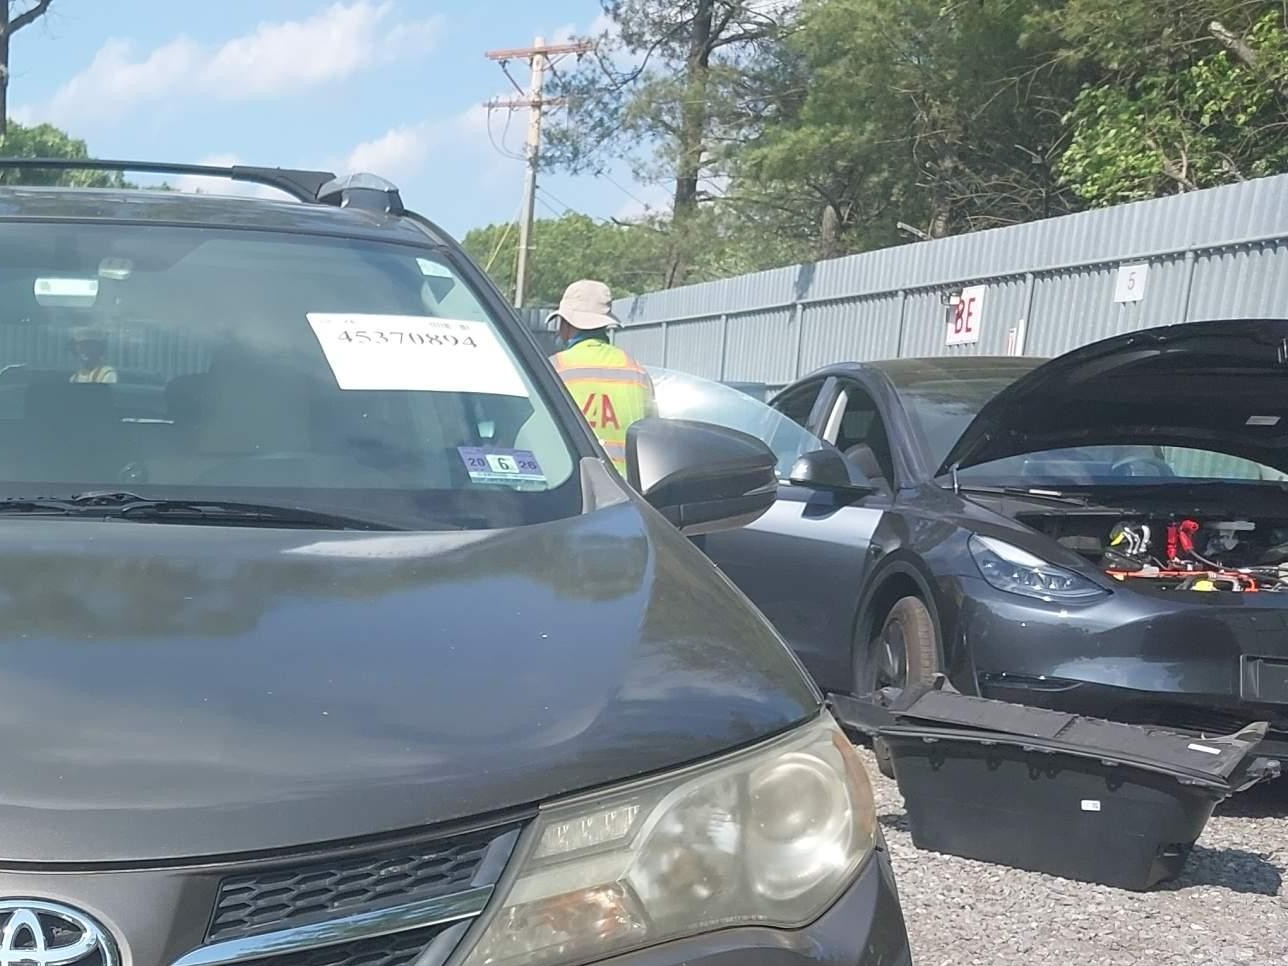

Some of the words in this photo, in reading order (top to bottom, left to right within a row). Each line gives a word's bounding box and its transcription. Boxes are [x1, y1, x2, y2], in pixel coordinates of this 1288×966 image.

[1127, 271, 1137, 290] 5
[954, 297, 976, 334] BE
[337, 330, 478, 348] 45370894
[468, 457, 486, 467] 20
[497, 457, 510, 470] 6
